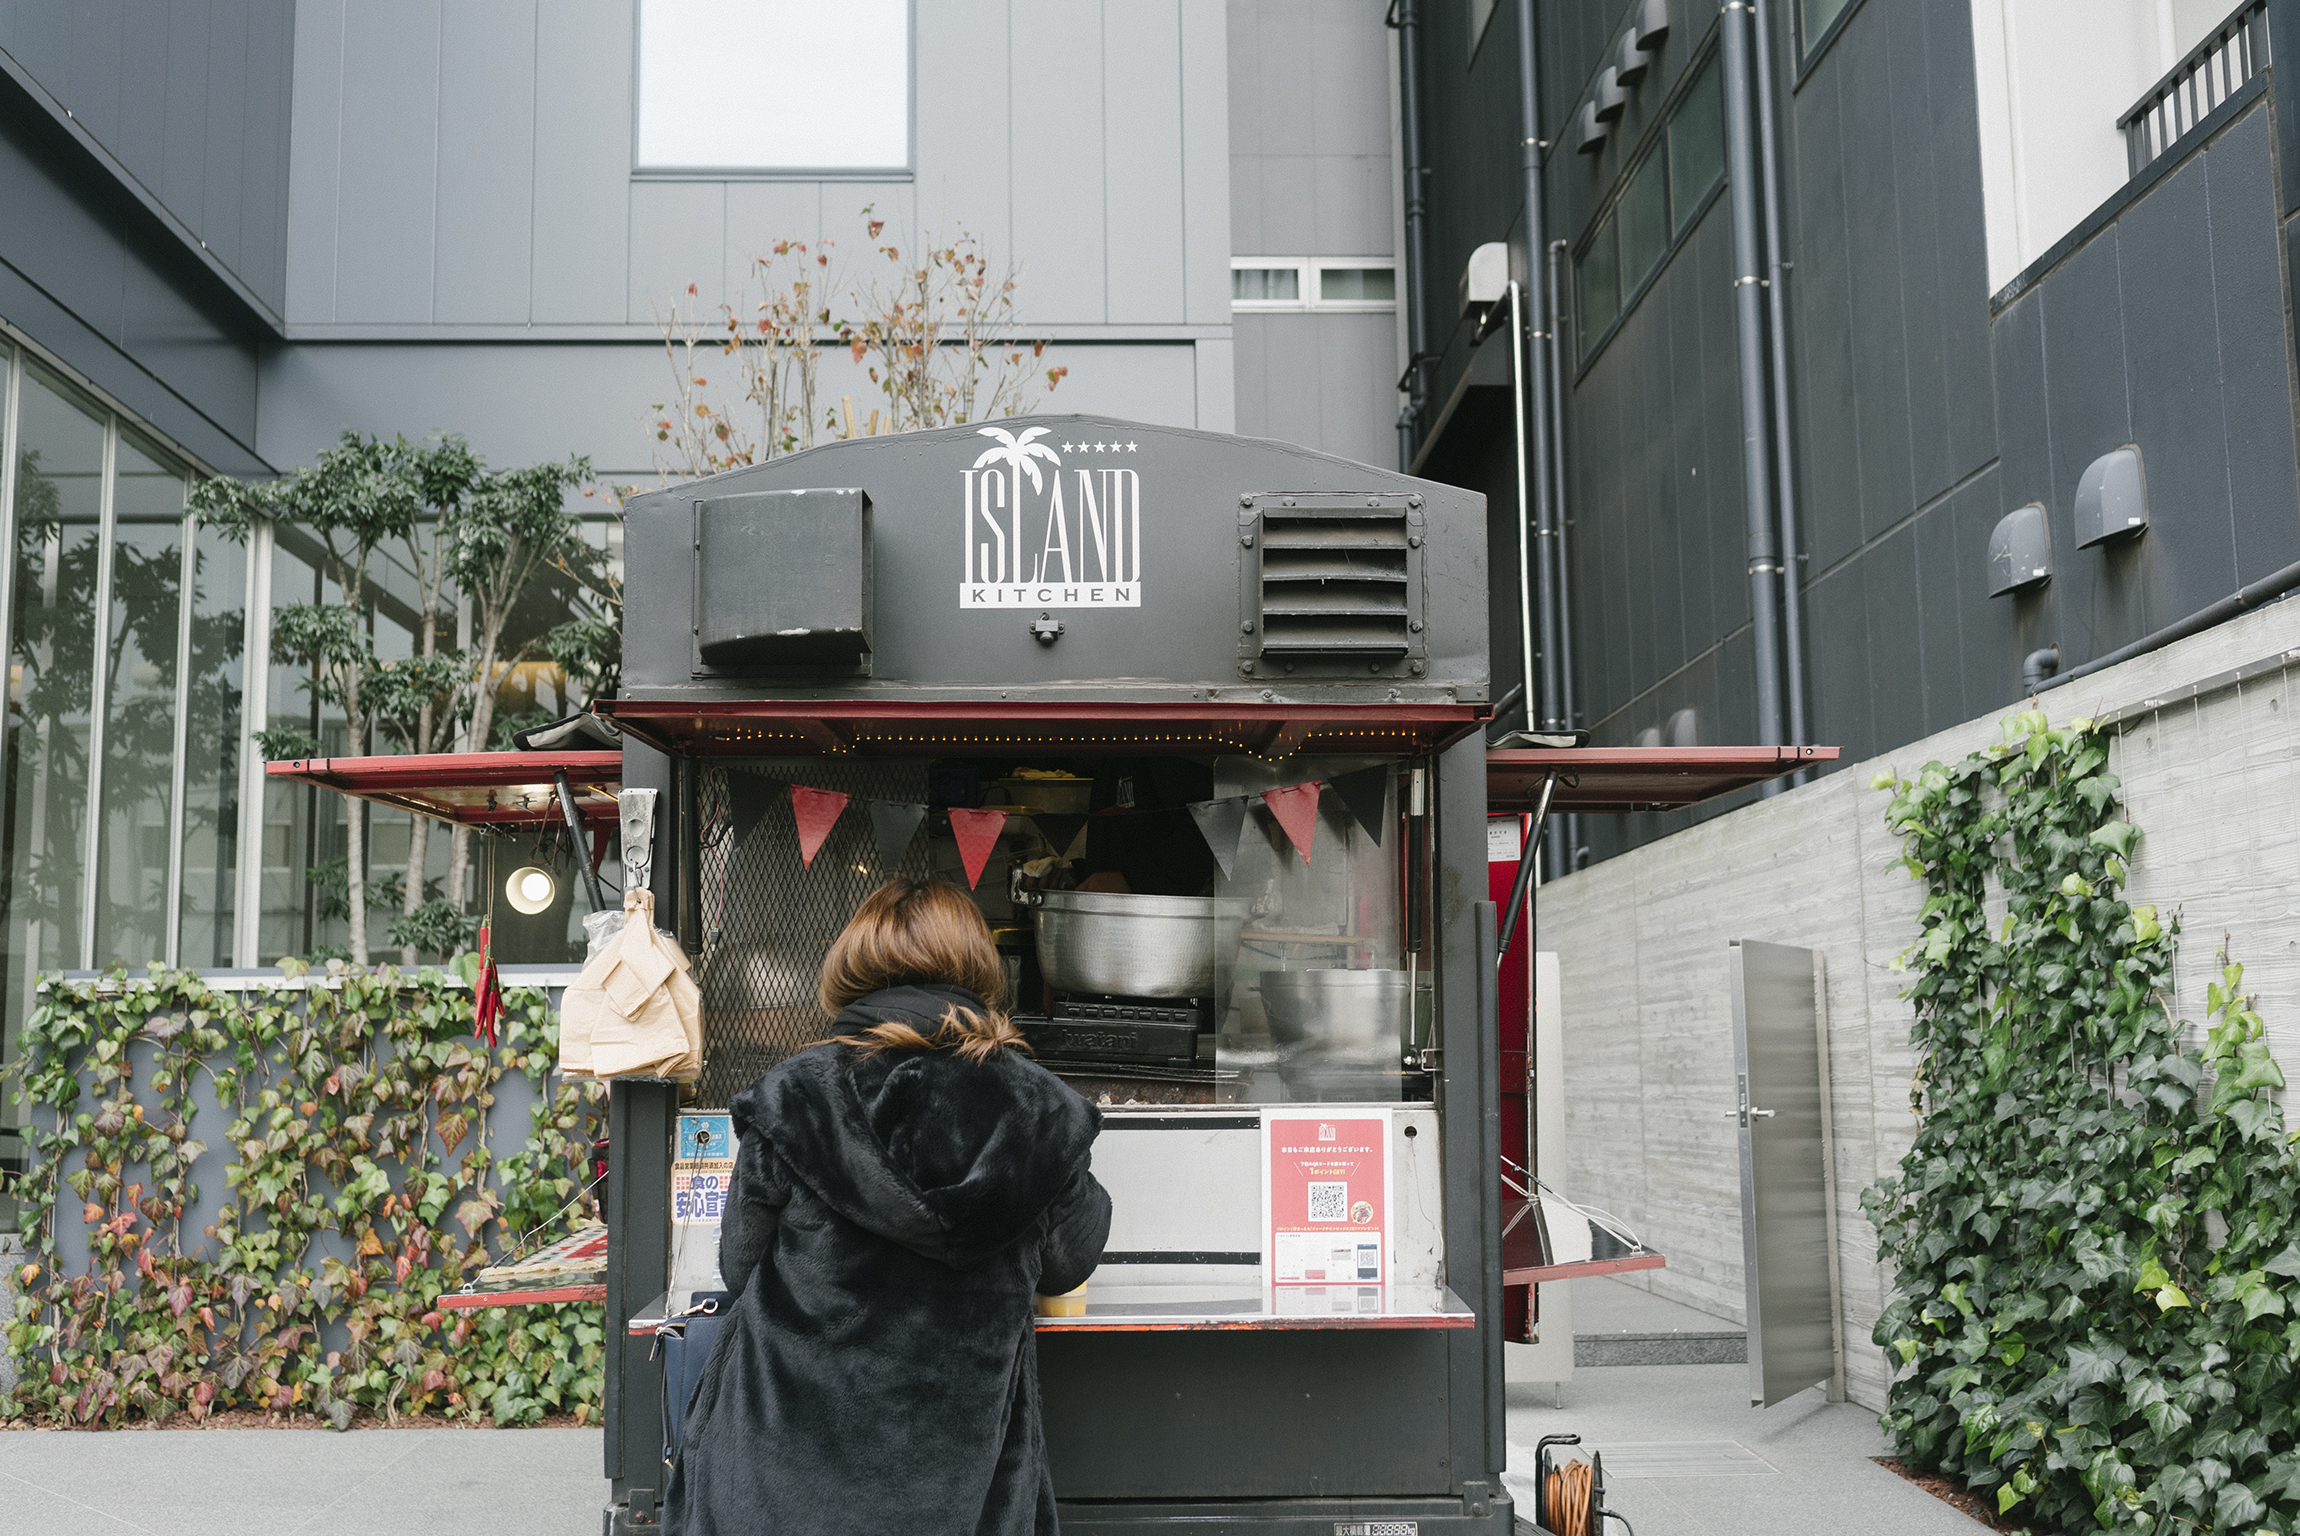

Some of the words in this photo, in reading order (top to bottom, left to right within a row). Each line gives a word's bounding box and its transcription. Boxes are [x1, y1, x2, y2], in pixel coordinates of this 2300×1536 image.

[960, 468, 1141, 584] ISLAND
[972, 588, 1130, 603] KITCHEN
[1061, 1029, 1137, 1049] Iwatani
[690, 1175, 719, 1190] 食の
